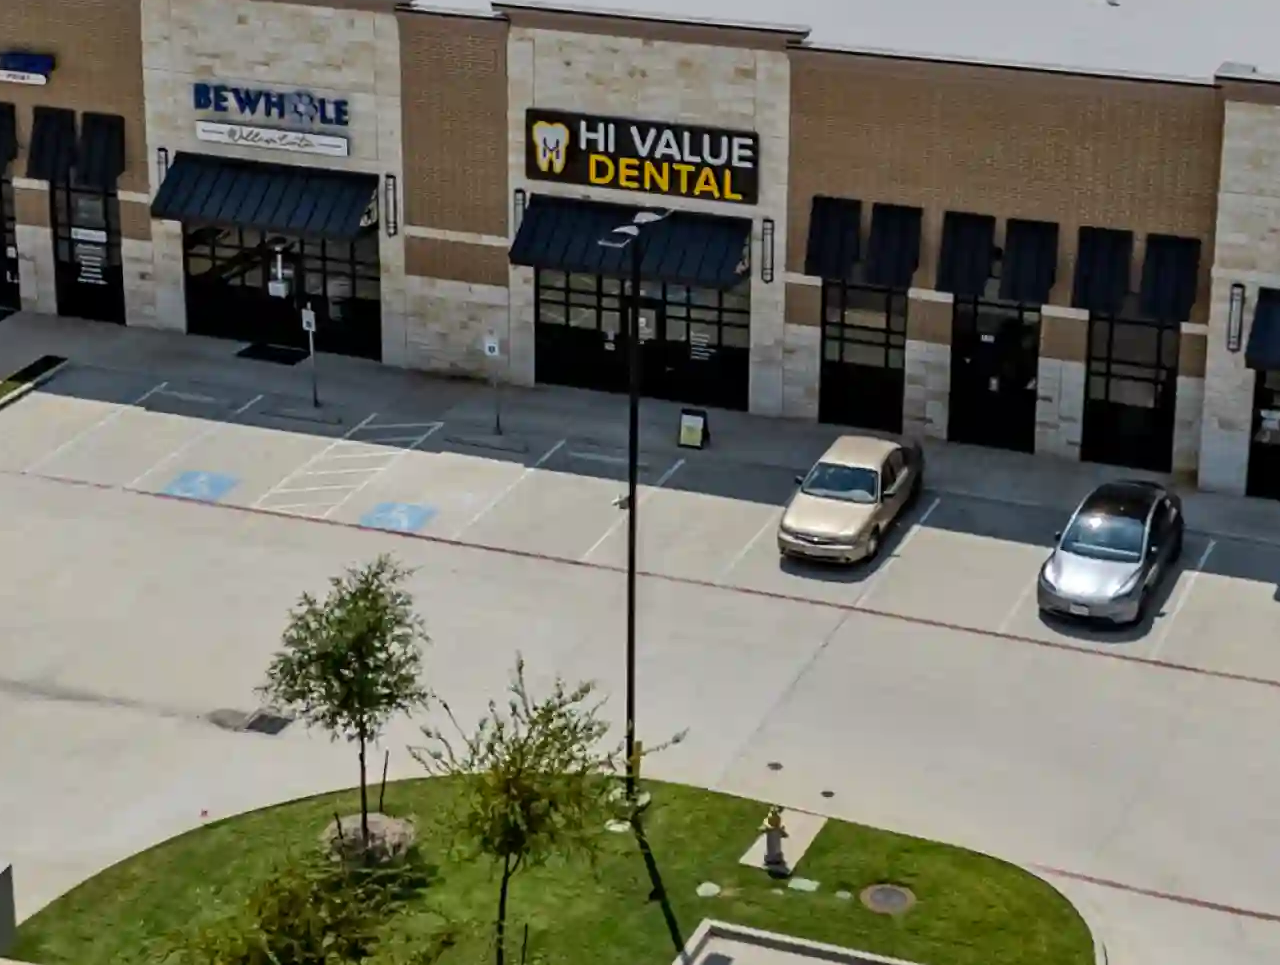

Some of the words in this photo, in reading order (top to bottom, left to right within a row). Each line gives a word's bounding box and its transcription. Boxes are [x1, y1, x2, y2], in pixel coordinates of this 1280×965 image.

[578, 119, 616, 153] HI
[630, 125, 754, 169] VALUE
[588, 153, 744, 201] DENTAL
